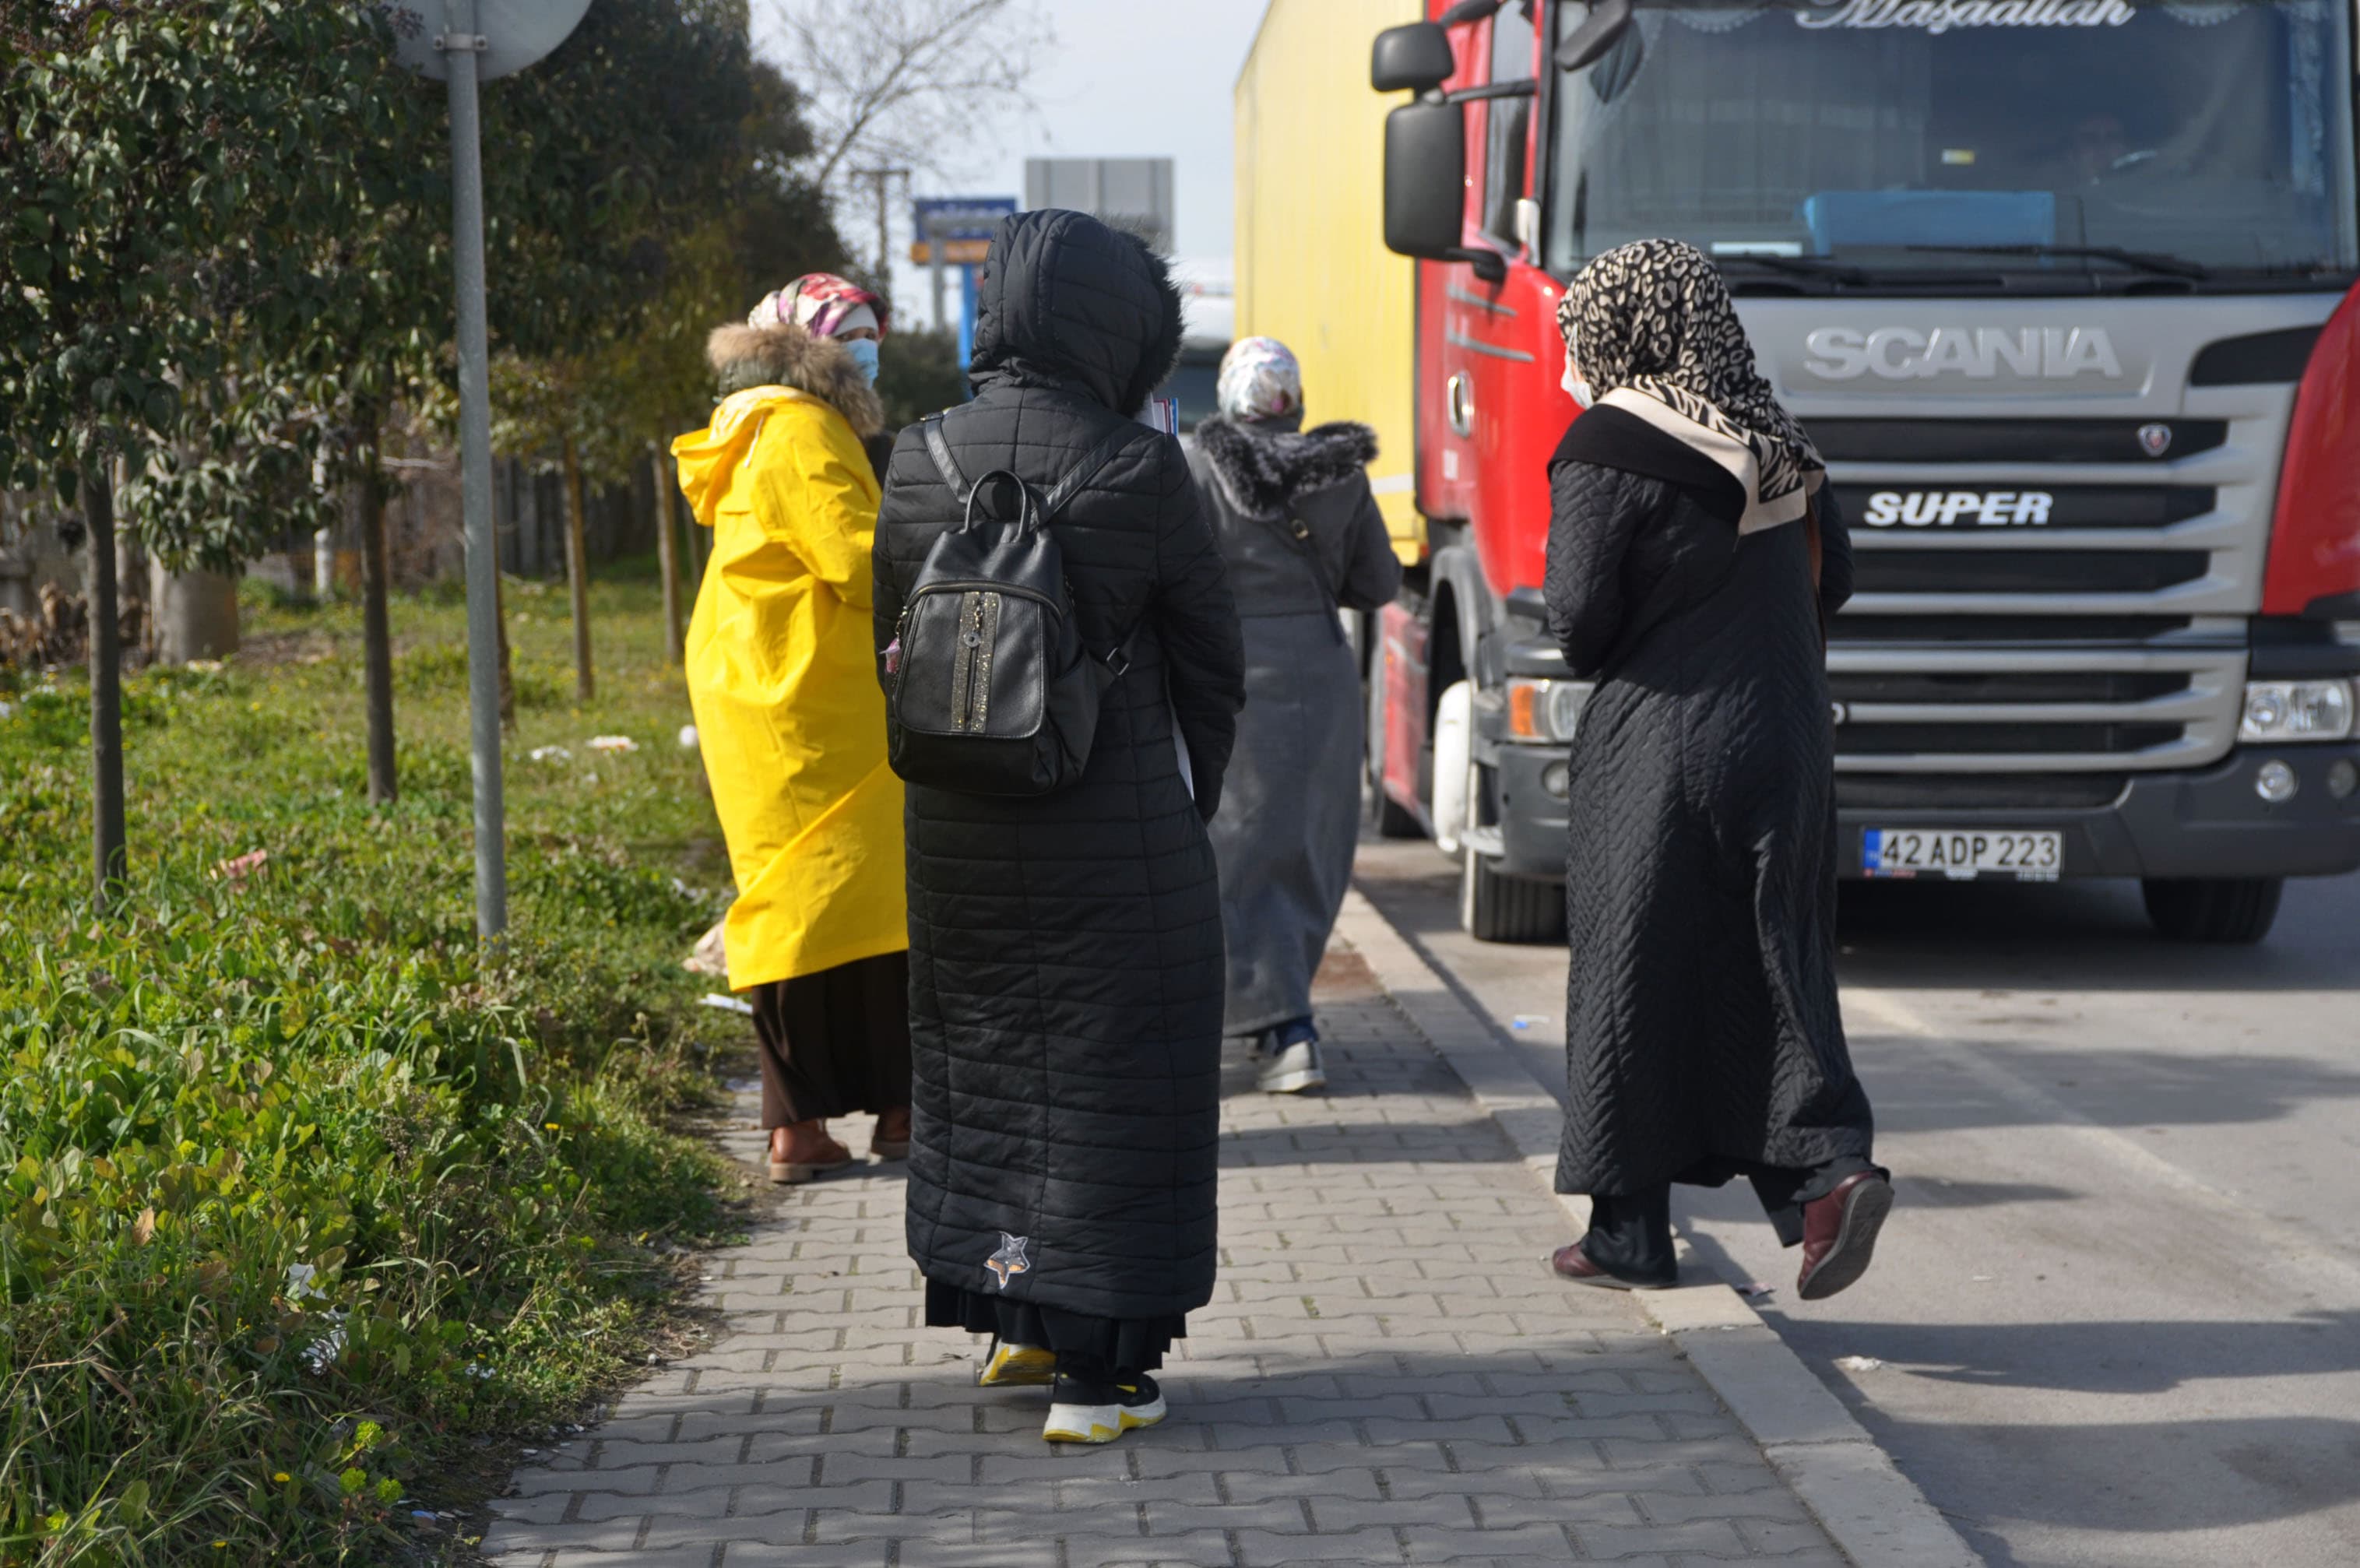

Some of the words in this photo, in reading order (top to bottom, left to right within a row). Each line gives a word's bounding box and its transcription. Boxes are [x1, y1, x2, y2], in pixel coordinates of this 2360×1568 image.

[1803, 325, 2123, 381] SCANIA
[1864, 490, 2053, 526] SUPER
[1883, 835, 1922, 865] 42
[1930, 835, 1988, 865] ADP
[1997, 836, 2056, 867] 223
